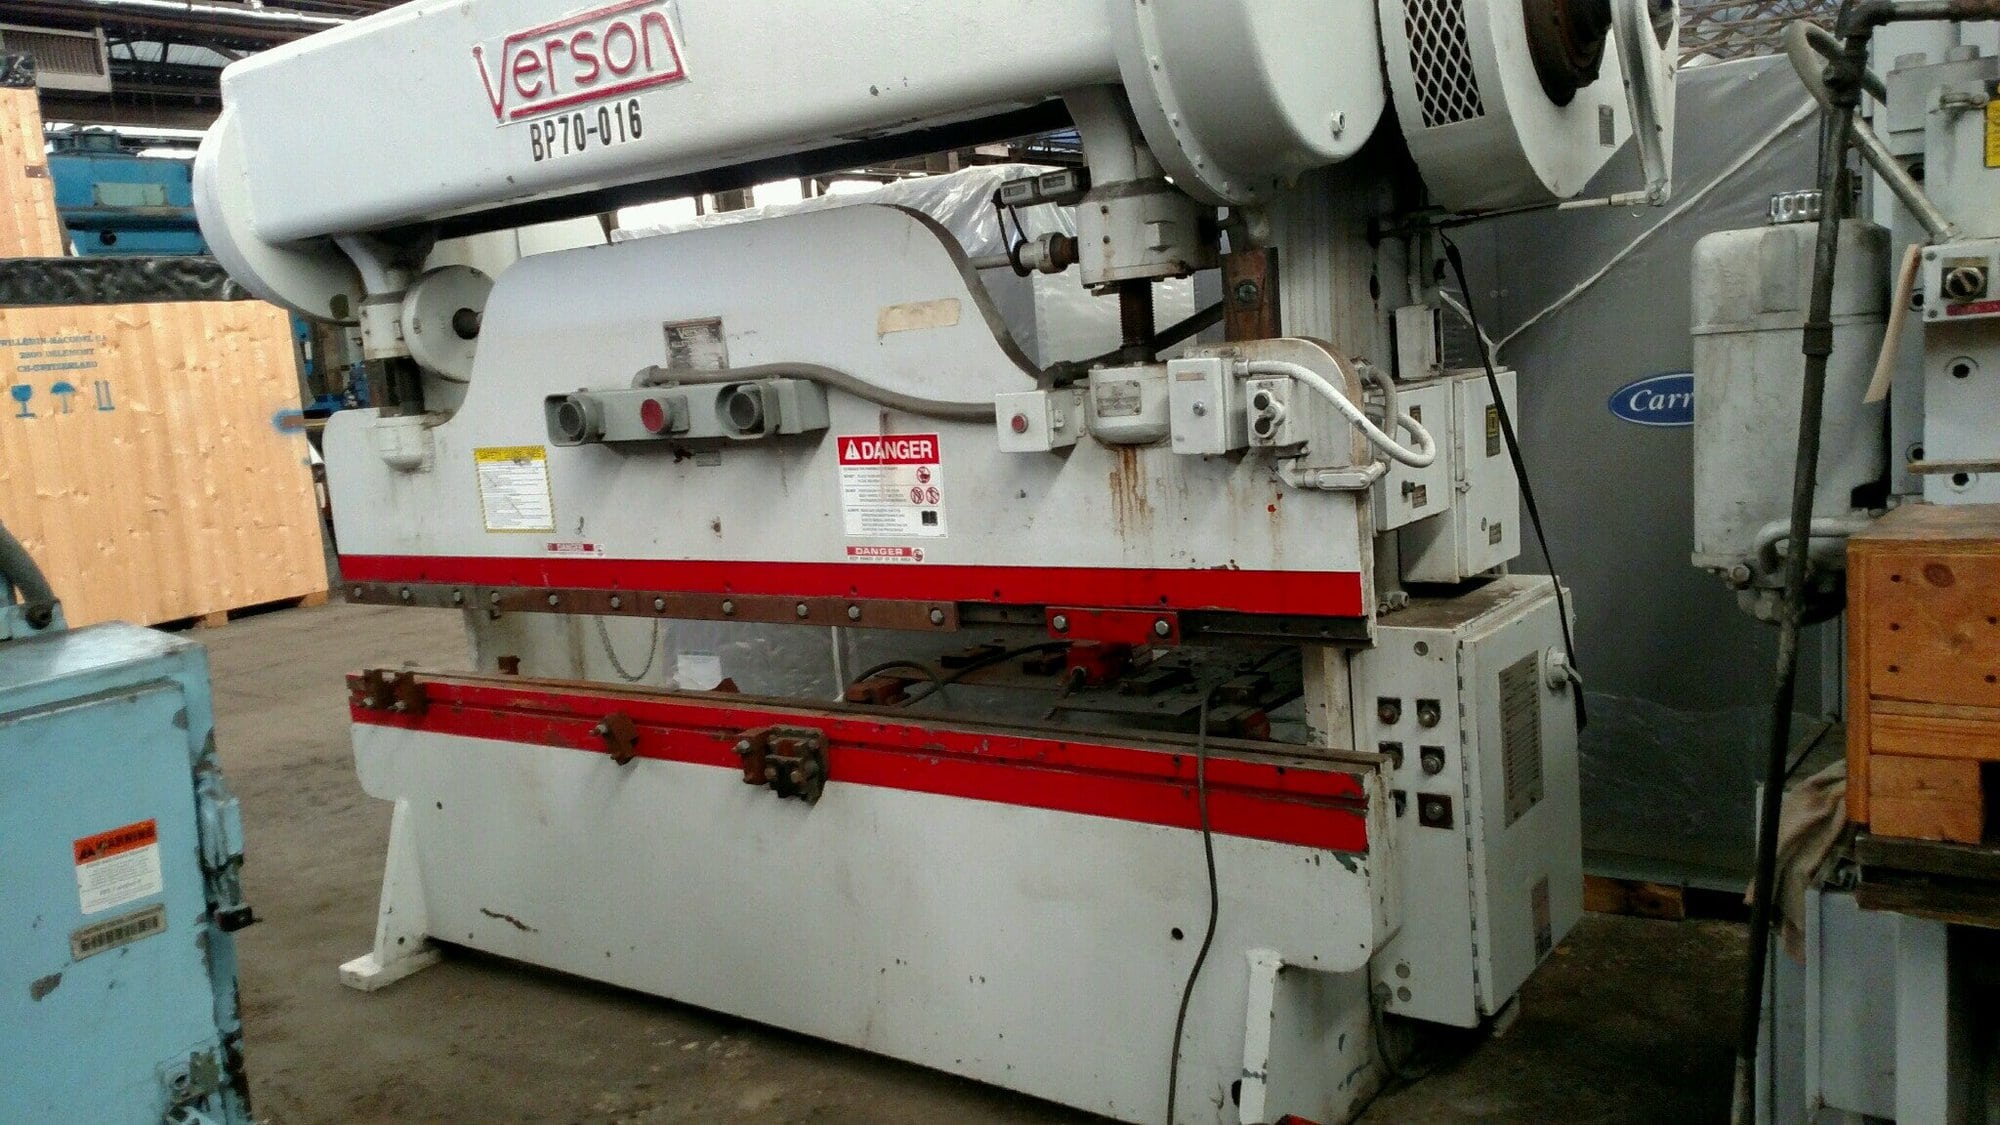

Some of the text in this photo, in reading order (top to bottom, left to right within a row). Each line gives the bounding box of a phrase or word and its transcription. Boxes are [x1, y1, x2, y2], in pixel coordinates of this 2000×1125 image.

[472, 8, 685, 119] Verson
[529, 98, 642, 162] BP70-016
[861, 440, 933, 460] DANGER
[855, 547, 903, 556] DANGER
